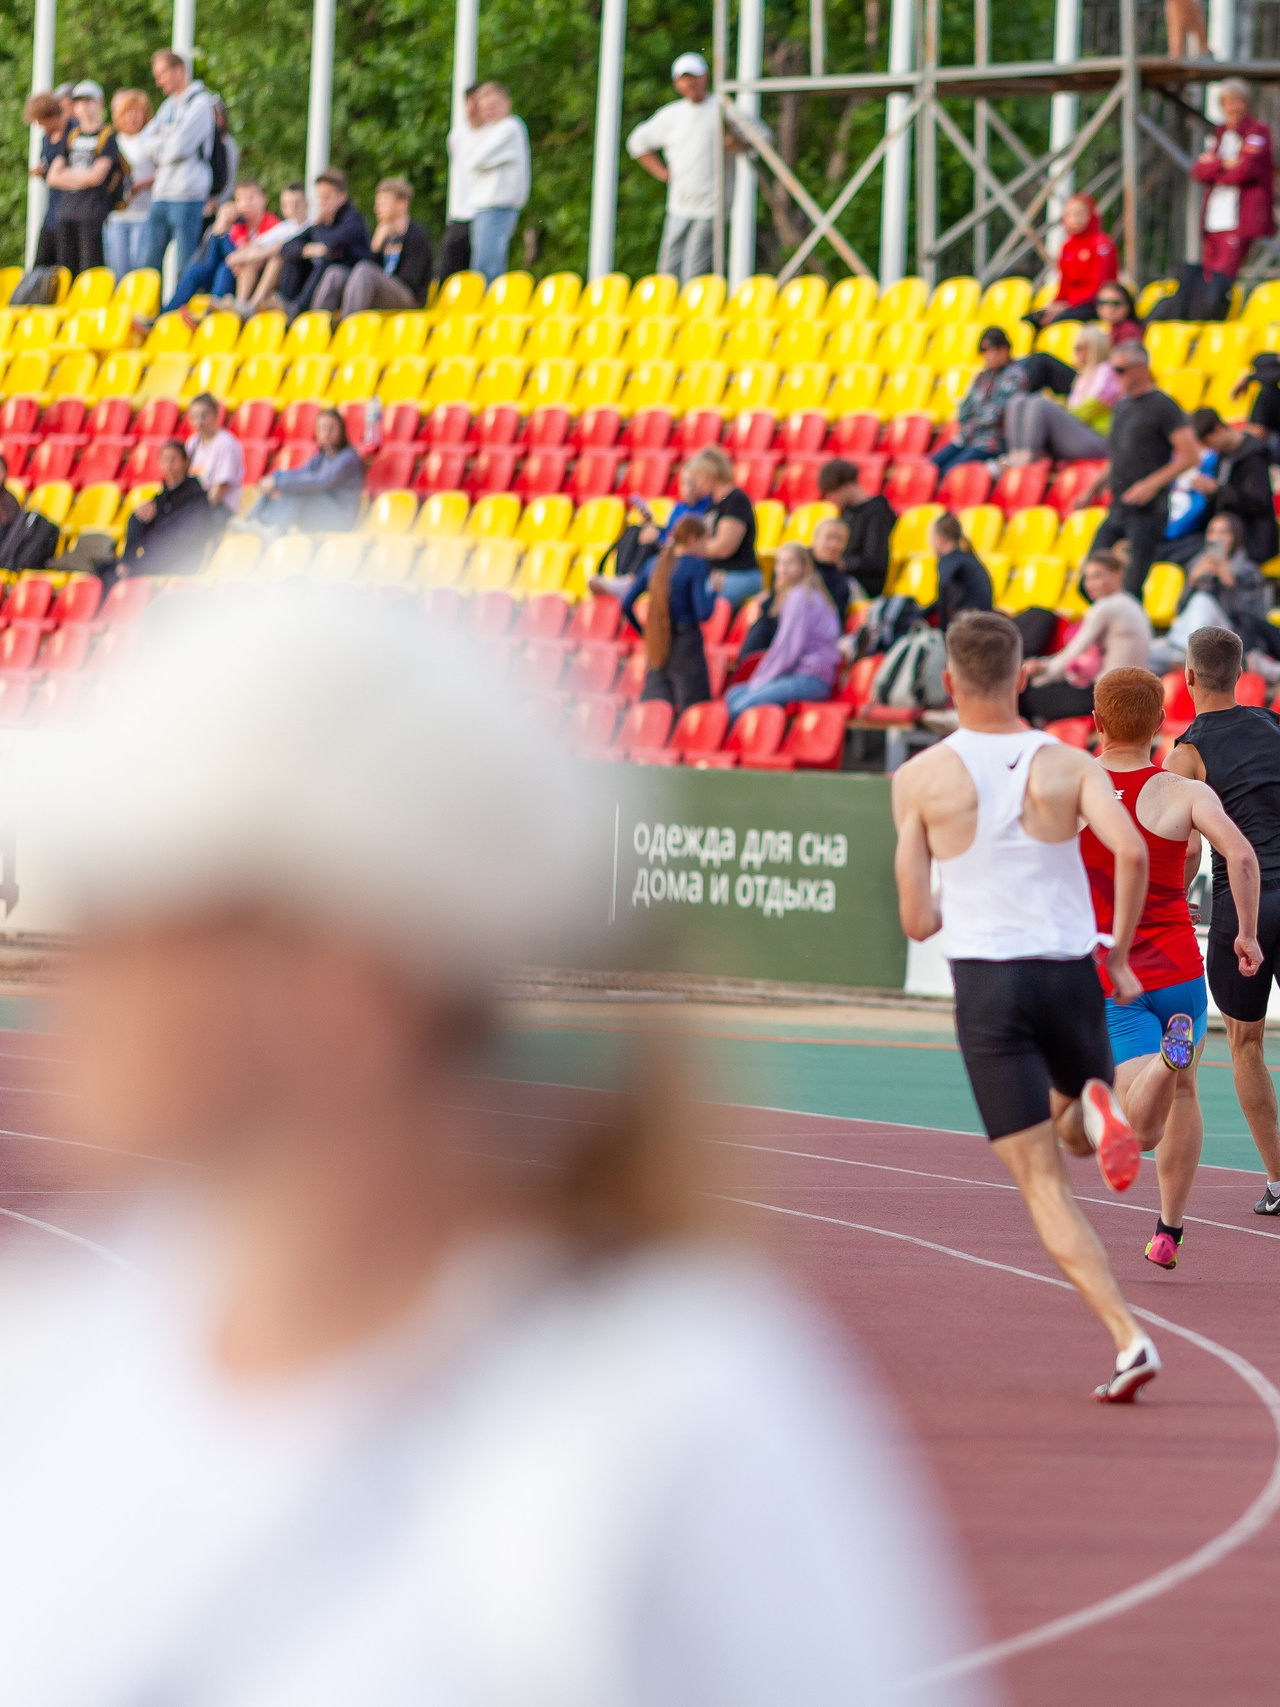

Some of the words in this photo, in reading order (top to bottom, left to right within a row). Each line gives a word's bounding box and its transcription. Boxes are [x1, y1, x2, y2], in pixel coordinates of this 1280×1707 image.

[632, 821, 737, 867] одежда
[740, 828, 794, 870] для
[798, 832, 849, 867] сна
[631, 866, 704, 908] дома
[708, 873, 729, 905] и
[734, 873, 837, 919] отдыха
